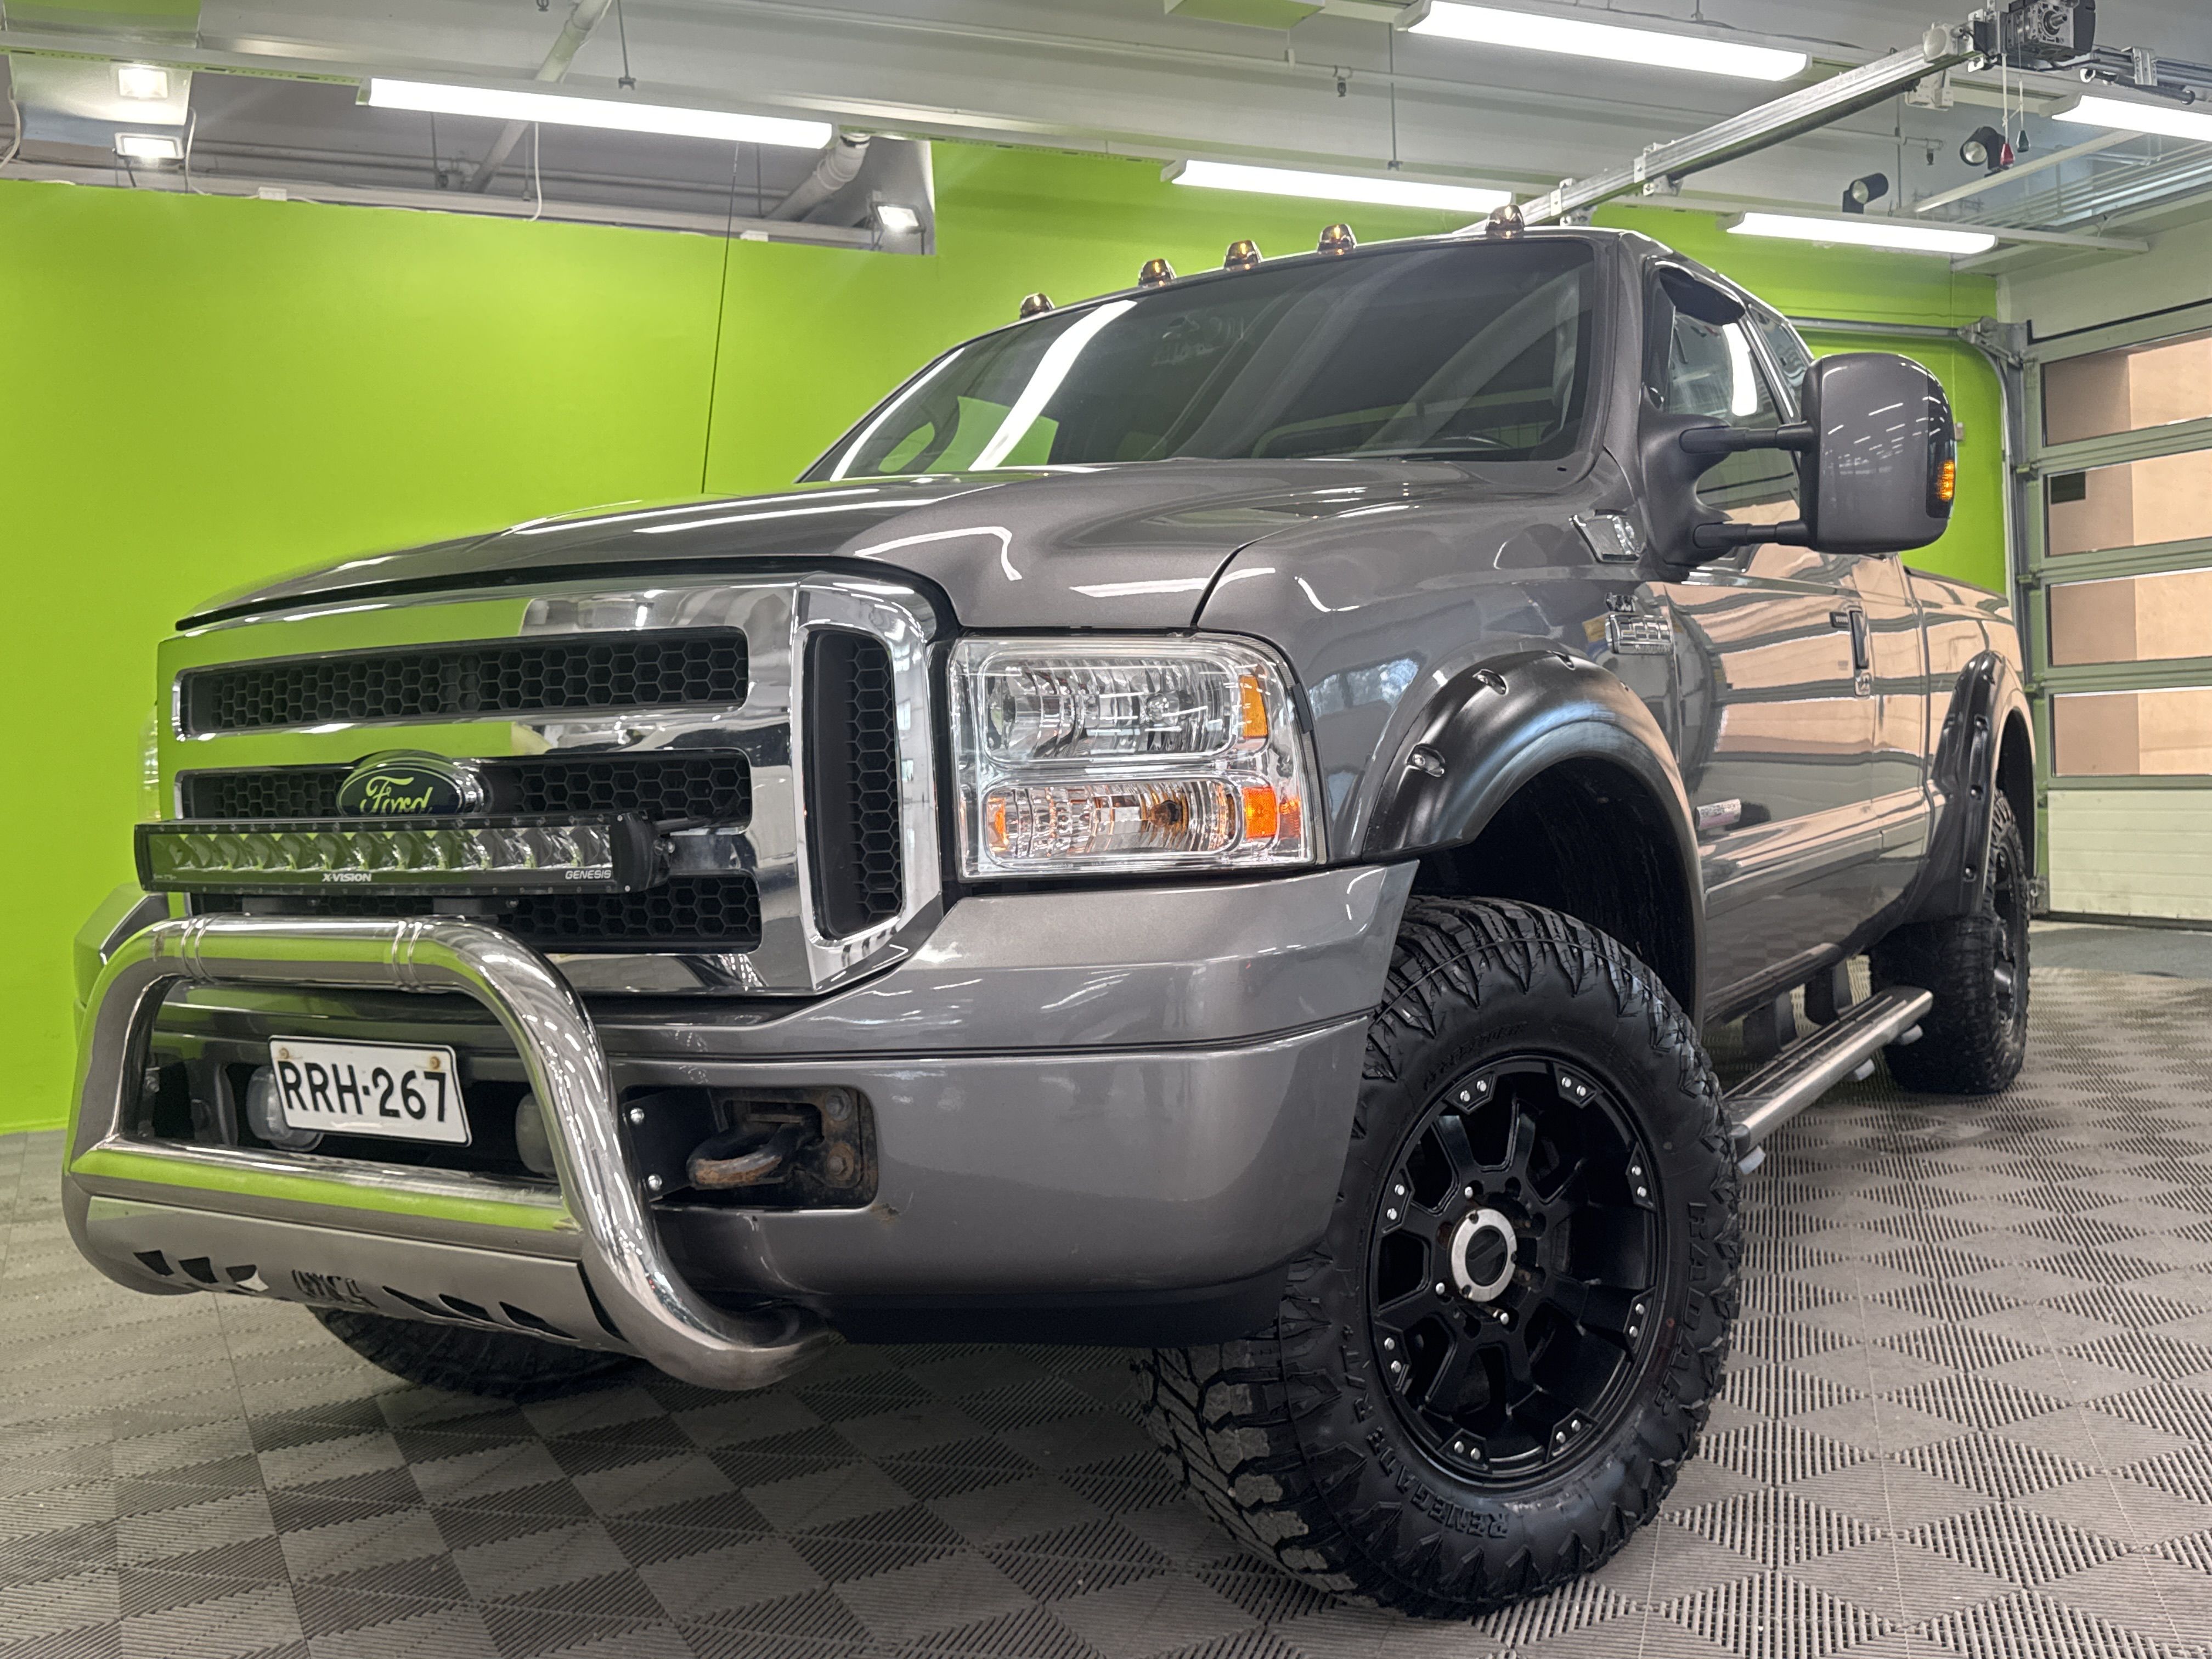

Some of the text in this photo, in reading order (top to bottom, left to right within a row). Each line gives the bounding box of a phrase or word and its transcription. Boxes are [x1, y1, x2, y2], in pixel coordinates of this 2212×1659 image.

[359, 776, 433, 815] Ford
[321, 873, 372, 882] X-VISION
[565, 870, 612, 880] GENESIS
[277, 1060, 447, 1122] RRH-267
